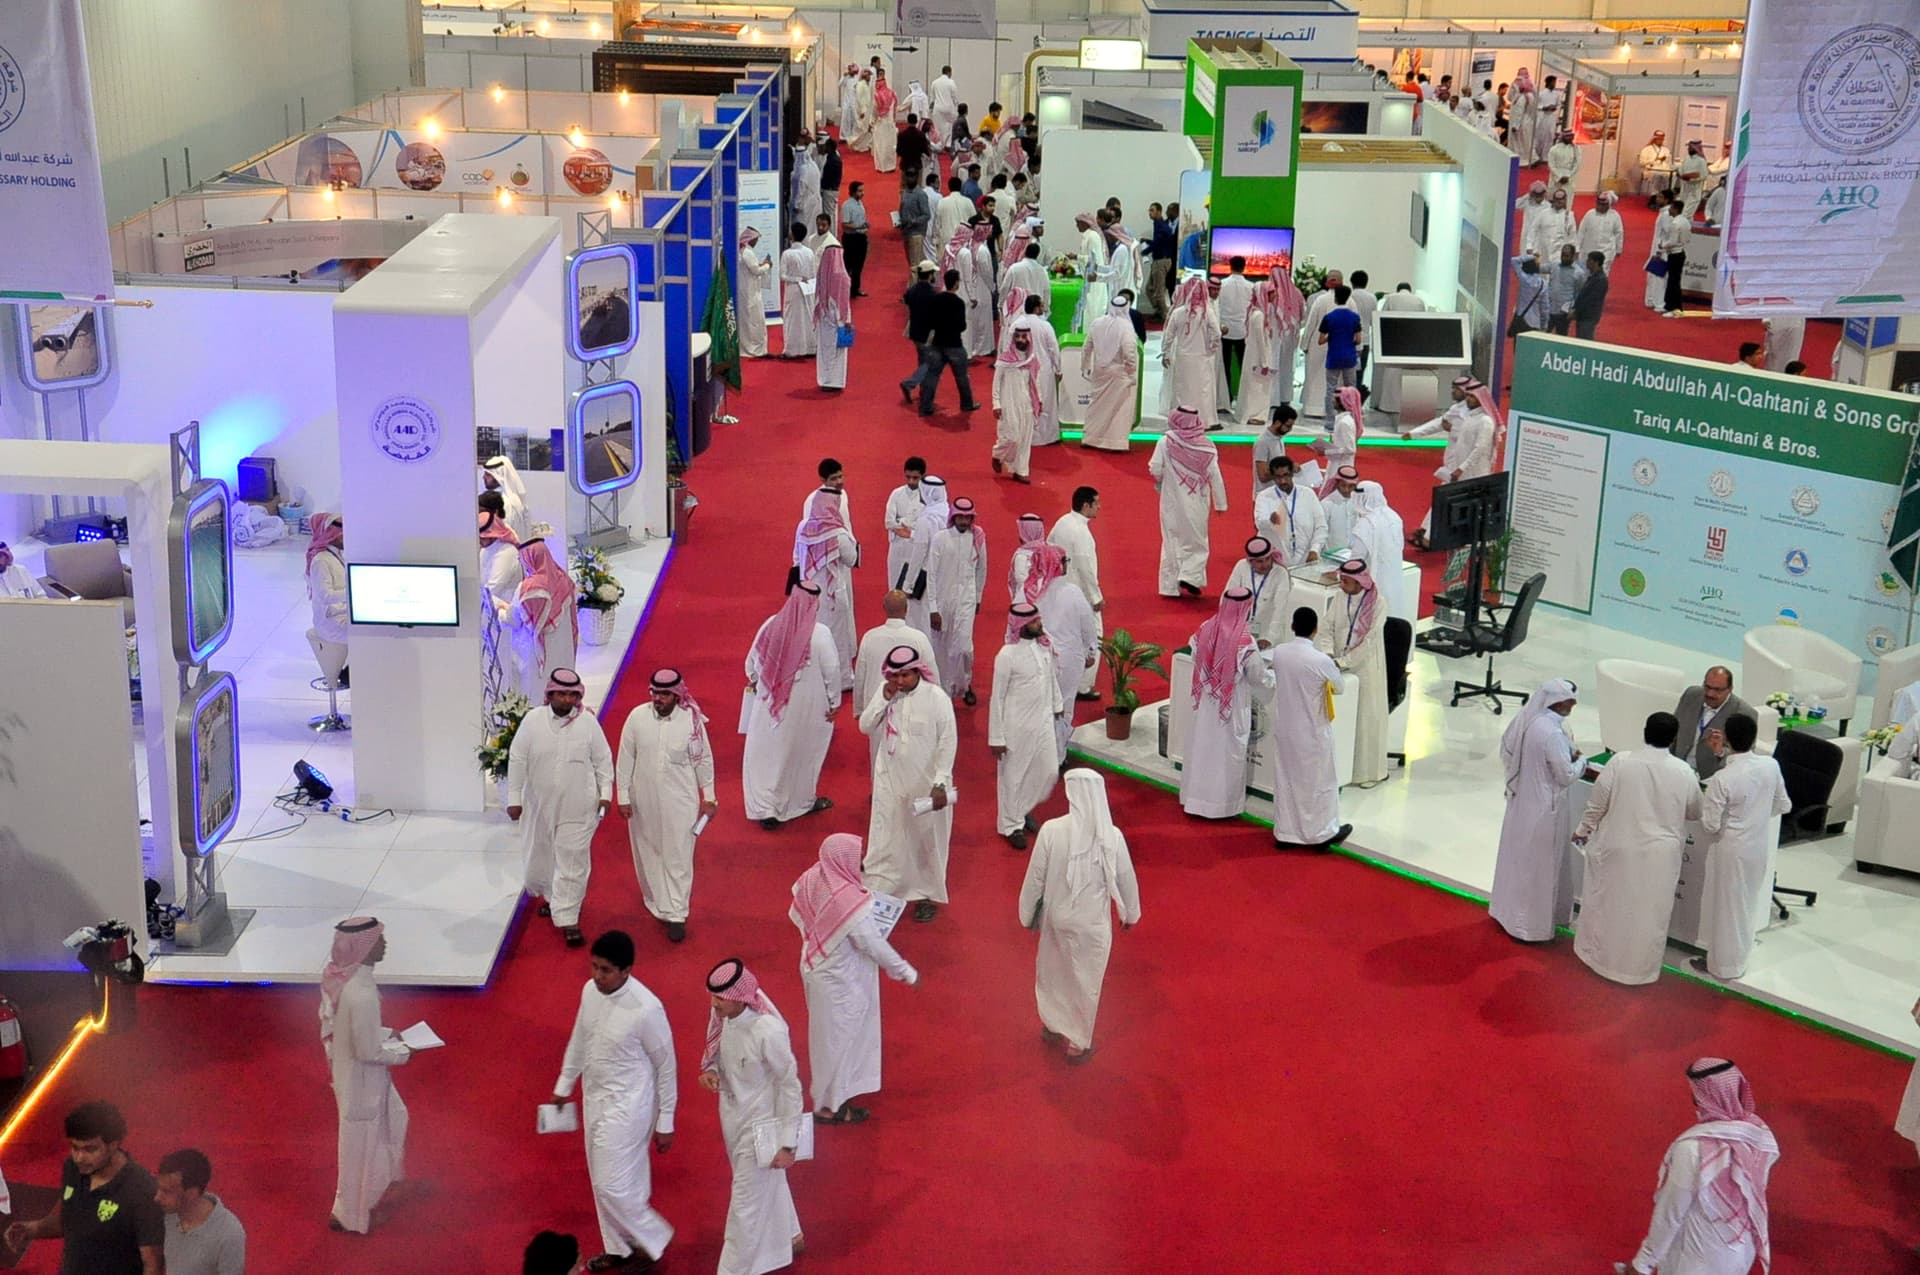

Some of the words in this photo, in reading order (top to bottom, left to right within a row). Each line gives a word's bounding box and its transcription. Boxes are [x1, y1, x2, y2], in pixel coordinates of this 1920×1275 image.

[43, 152, 73, 167] شركة
[30, 176, 77, 188] HOLDING
[1816, 184, 1880, 209] AHQ
[1541, 351, 1586, 375] Abdel
[1591, 357, 1628, 384] Hadi
[1632, 364, 1708, 398] Abdullah
[1711, 382, 1809, 417] Al-Qahtani
[1814, 402, 1828, 420] &
[1833, 402, 1882, 430] Sons
[1633, 409, 1671, 434] Tariq
[1675, 417, 1759, 448] Al-Qahtani
[1762, 434, 1775, 450] &
[1779, 437, 1821, 459] Bros.
[1700, 585, 1724, 600] AHQ
